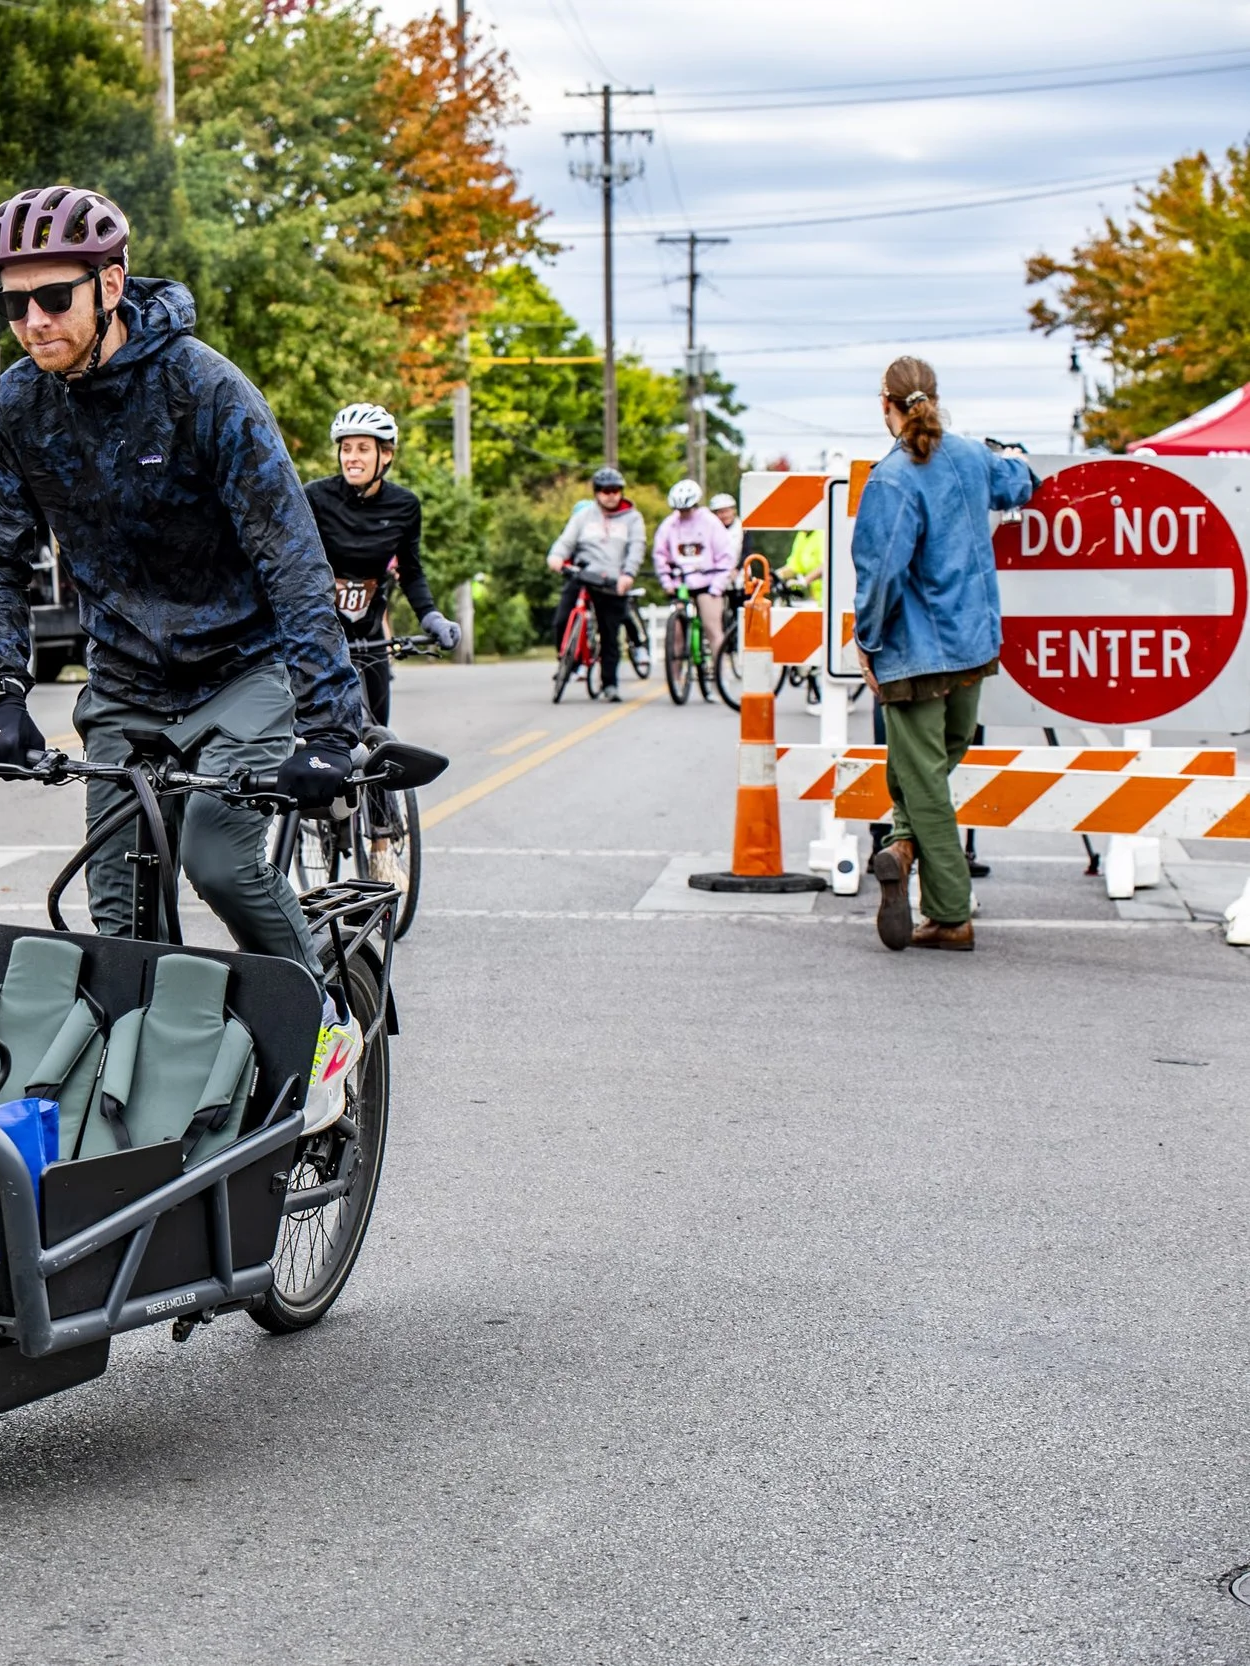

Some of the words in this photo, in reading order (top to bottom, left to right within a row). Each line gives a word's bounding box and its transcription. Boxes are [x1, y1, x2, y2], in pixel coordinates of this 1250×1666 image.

[1020, 506, 1083, 556] DO
[1114, 506, 1206, 556] NOT
[338, 589, 367, 610] 181
[1037, 629, 1191, 678] ENTER
